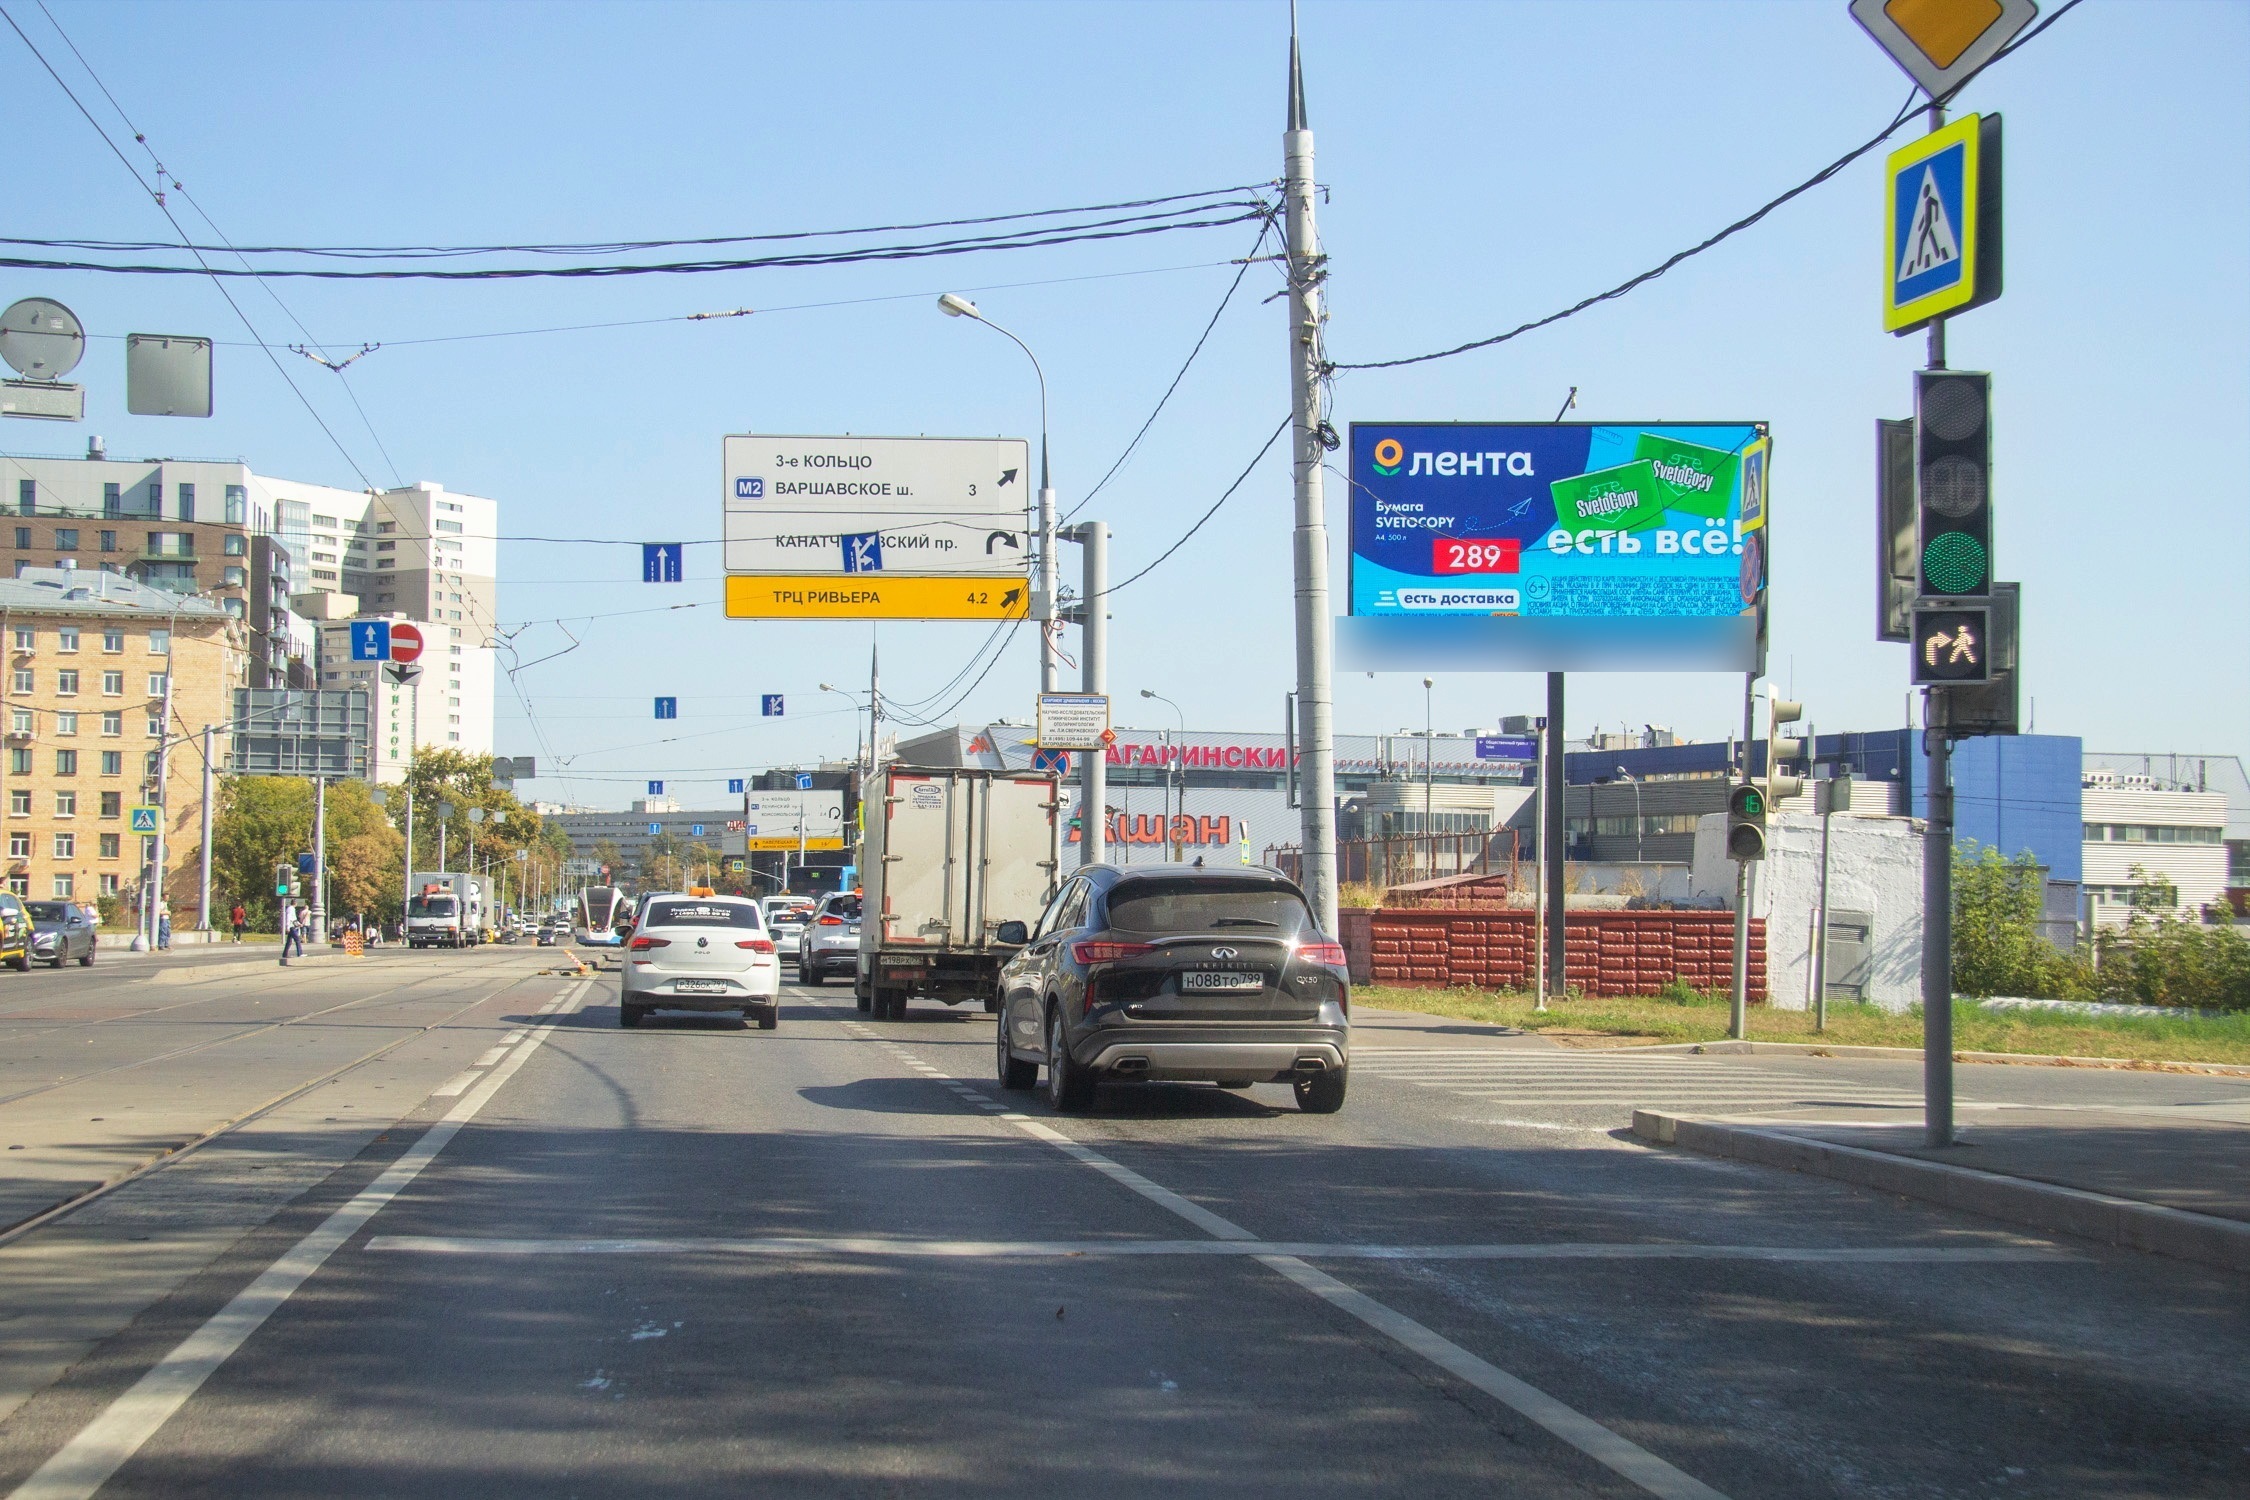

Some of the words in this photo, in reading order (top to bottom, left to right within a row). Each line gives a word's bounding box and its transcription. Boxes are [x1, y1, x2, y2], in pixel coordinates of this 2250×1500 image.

[775, 454, 798, 468] 3-е
[804, 454, 872, 470] КОЛЬЦО
[1409, 451, 1534, 476] лента
[1652, 459, 1715, 493] SvetoCopy
[739, 481, 762, 495] М2
[775, 481, 891, 496] ВАРШАВСКОЕ
[896, 485, 914, 496] ш.
[968, 484, 977, 496] 3
[1375, 500, 1424, 514] Бумага
[1575, 489, 1639, 518] SvetoCopy
[1375, 516, 1455, 528] SVETOCOPY
[775, 533, 930, 549] КАНАТЧВСКИЙ
[935, 539, 958, 552] пр.
[1547, 529, 1642, 555] есть
[1655, 518, 1743, 556] всё!
[1449, 544, 1501, 569] 289
[1528, 581, 1546, 593] 6+
[773, 591, 803, 604] ТРЦ
[808, 592, 881, 604] РИВЬЕРА
[967, 592, 989, 604] 4.2
[1404, 594, 1437, 604] есть
[1440, 594, 1515, 606] доставка
[1105, 744, 1300, 769] АГАРИНСКИ
[1746, 795, 1759, 812] 16
[1195, 962, 1255, 970] INFINITI
[1296, 974, 1319, 985] QX50
